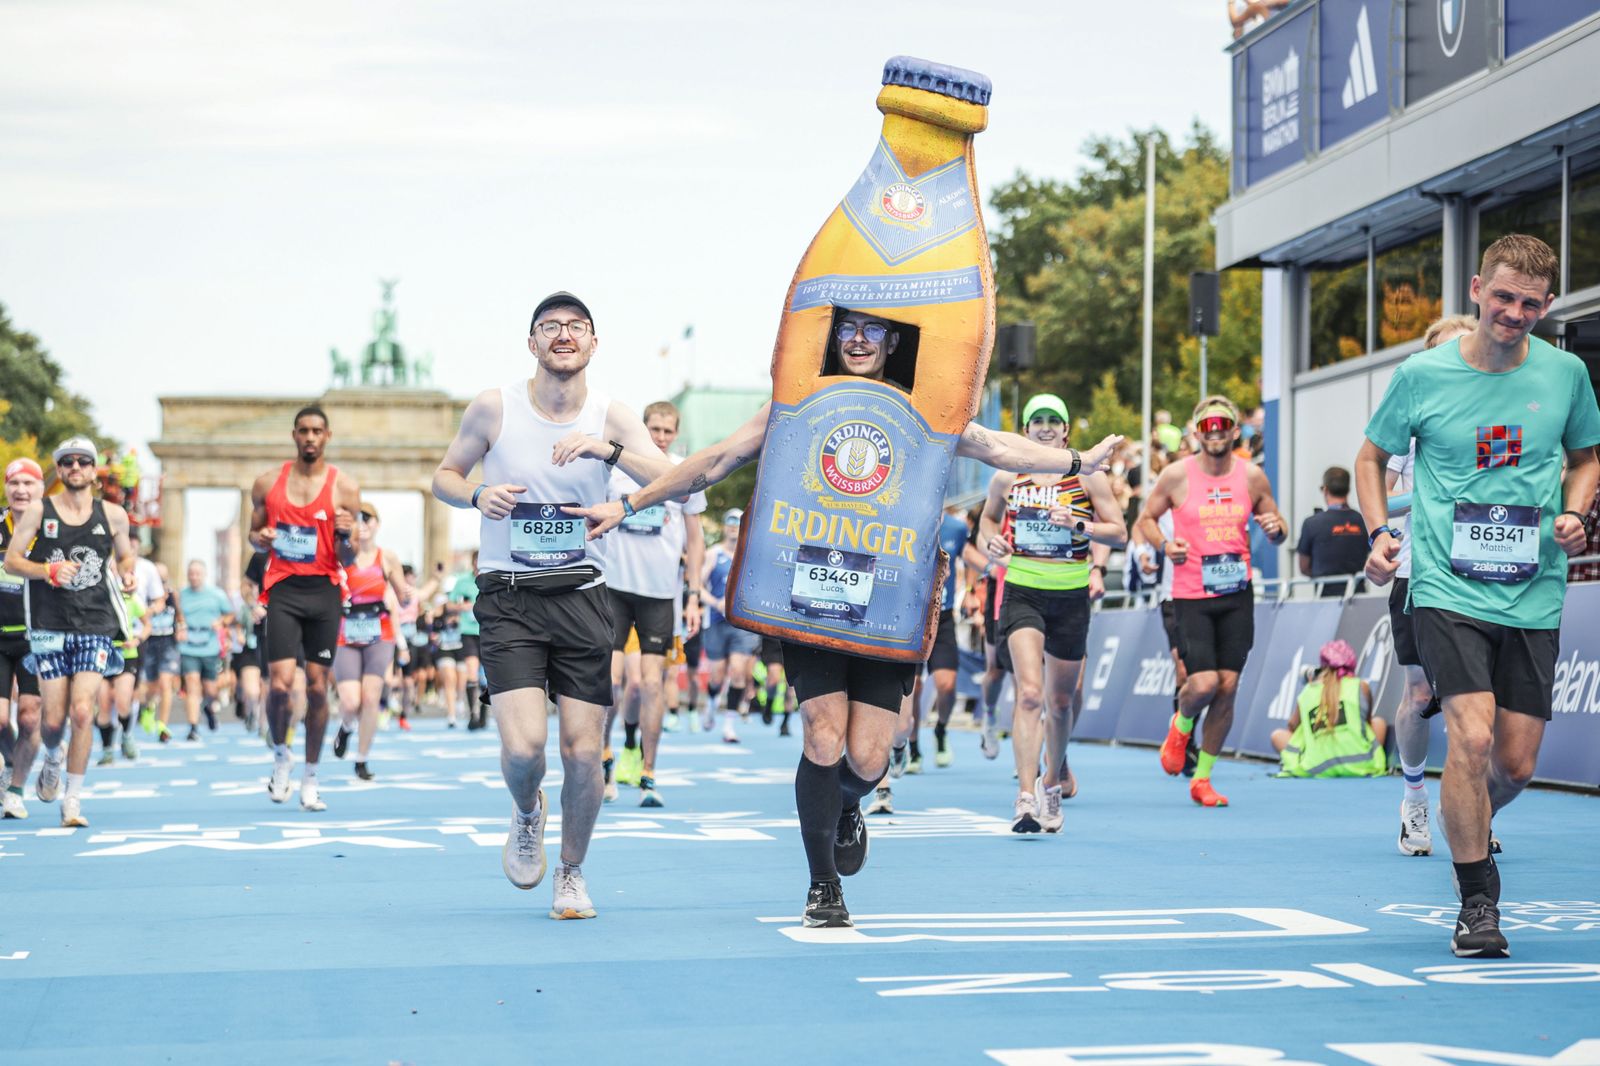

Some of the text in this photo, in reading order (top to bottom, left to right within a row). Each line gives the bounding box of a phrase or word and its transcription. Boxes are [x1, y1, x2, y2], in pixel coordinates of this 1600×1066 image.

[819, 287, 953, 300] KALORIENREDUZIERT
[826, 424, 890, 459] ERDINGER
[1199, 504, 1244, 517] BERLIN
[523, 521, 574, 535] 68283
[768, 499, 918, 563] ERDINGER
[1470, 525, 1524, 543] 86341
[540, 535, 557, 543] Emil
[1480, 543, 1513, 553] Matthis
[529, 552, 568, 560] zalando
[1472, 562, 1518, 574] zalando
[809, 567, 860, 586] 63449
[820, 583, 845, 593] Lucas
[809, 599, 850, 612] zalando
